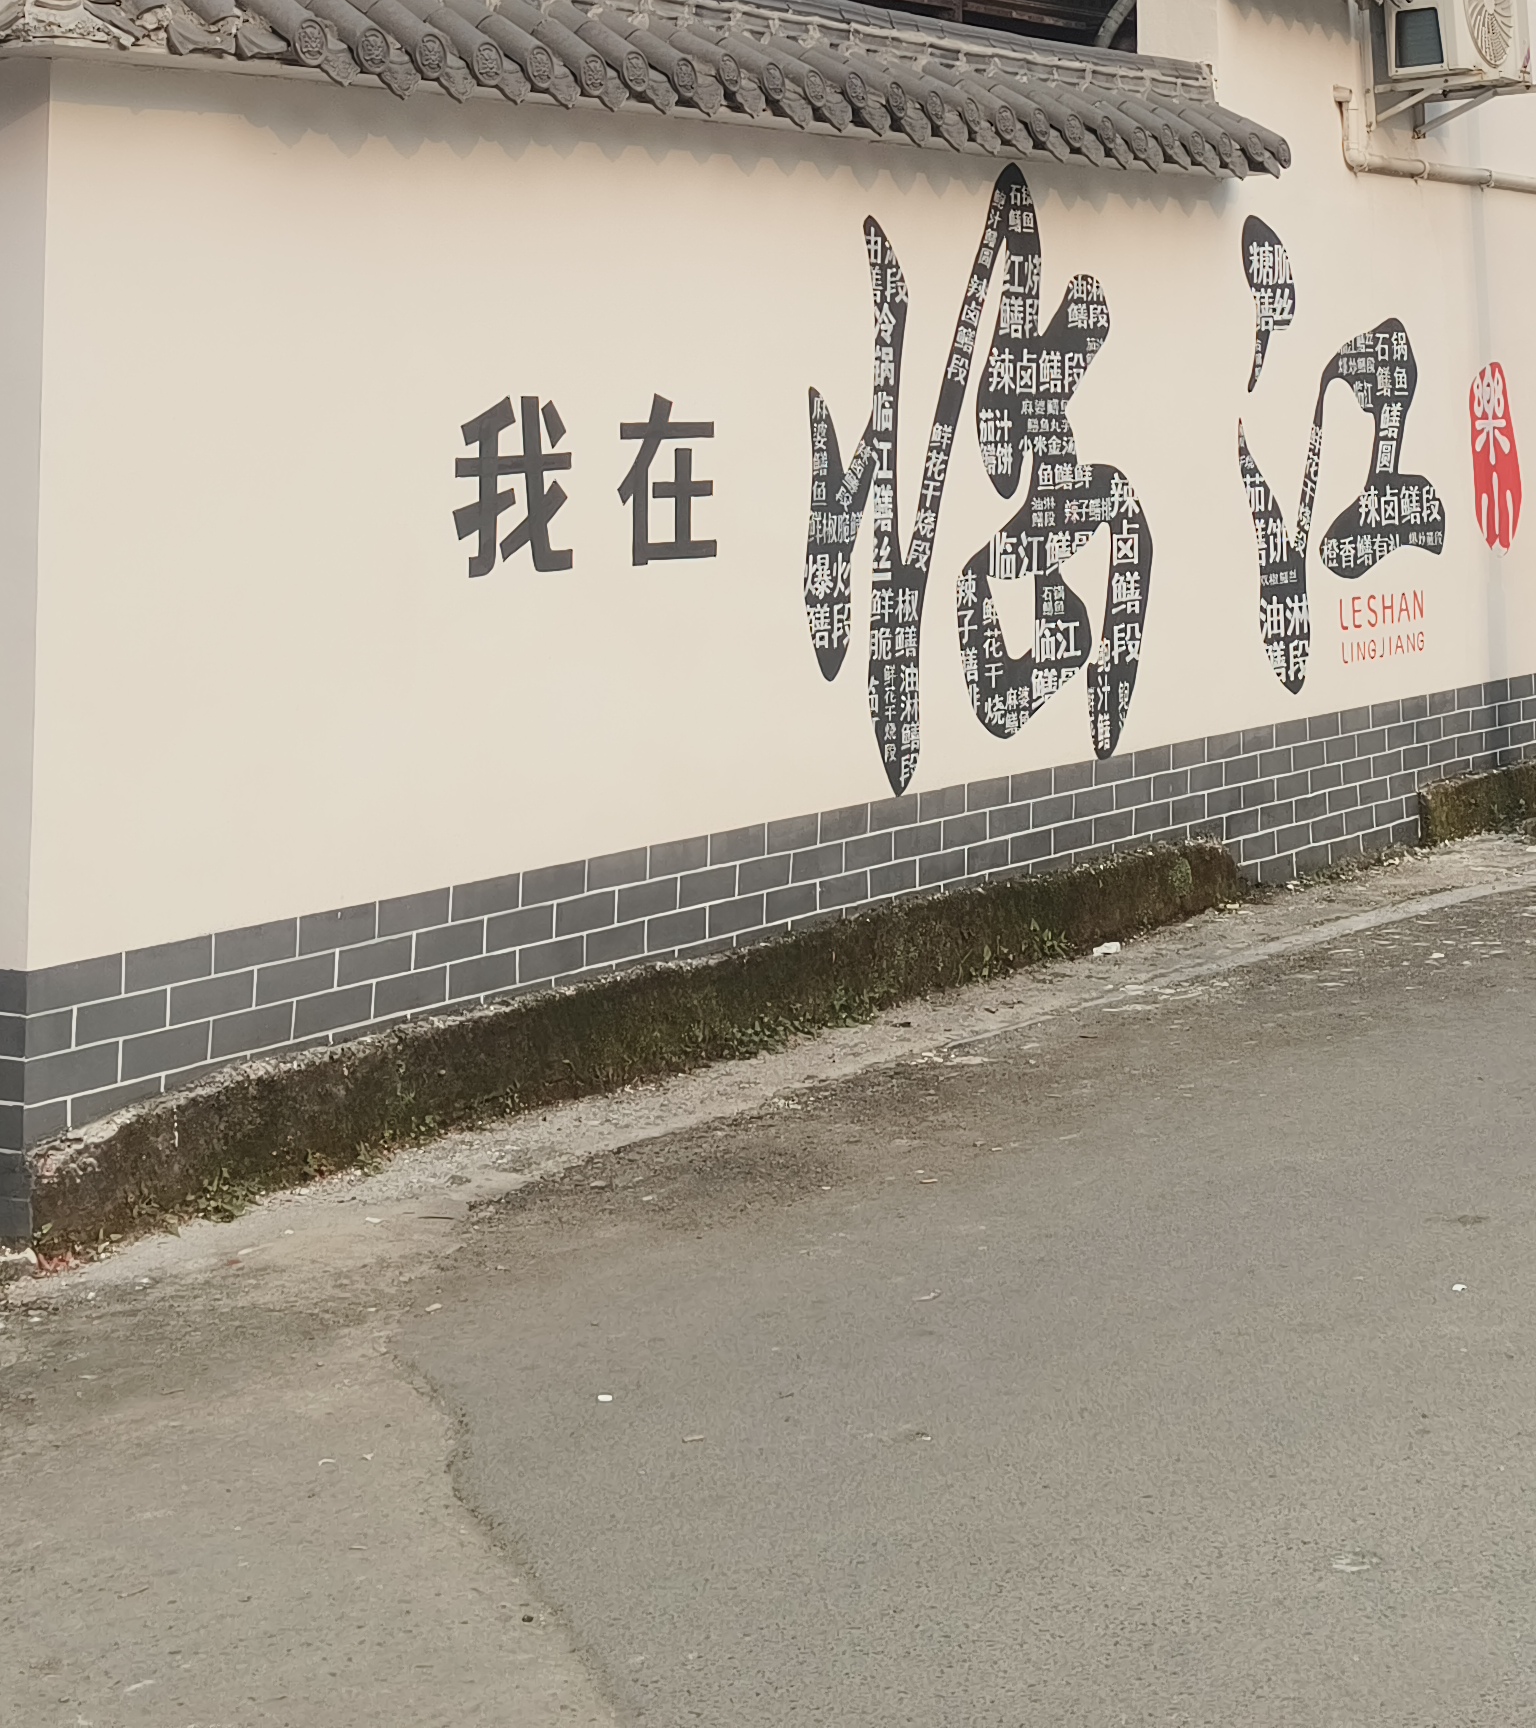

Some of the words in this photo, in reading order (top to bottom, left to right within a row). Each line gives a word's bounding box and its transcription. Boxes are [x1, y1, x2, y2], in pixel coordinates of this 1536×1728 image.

[1066, 302, 1109, 329] 鳝段
[1375, 332, 1408, 362] 石锅
[988, 347, 1089, 396] 辣卤鳝段
[1375, 366, 1409, 398] 鳝鱼
[979, 409, 1013, 442] 茄汁
[452, 392, 718, 578] 我在
[1358, 484, 1442, 529] 辣卤鳝段
[1110, 472, 1142, 666] 辣卤鳝段
[1261, 592, 1309, 639] 油淋
[1339, 589, 1424, 631] LESHAN
[1033, 618, 1082, 664] 临江
[1341, 631, 1425, 664] LINGJIANG
